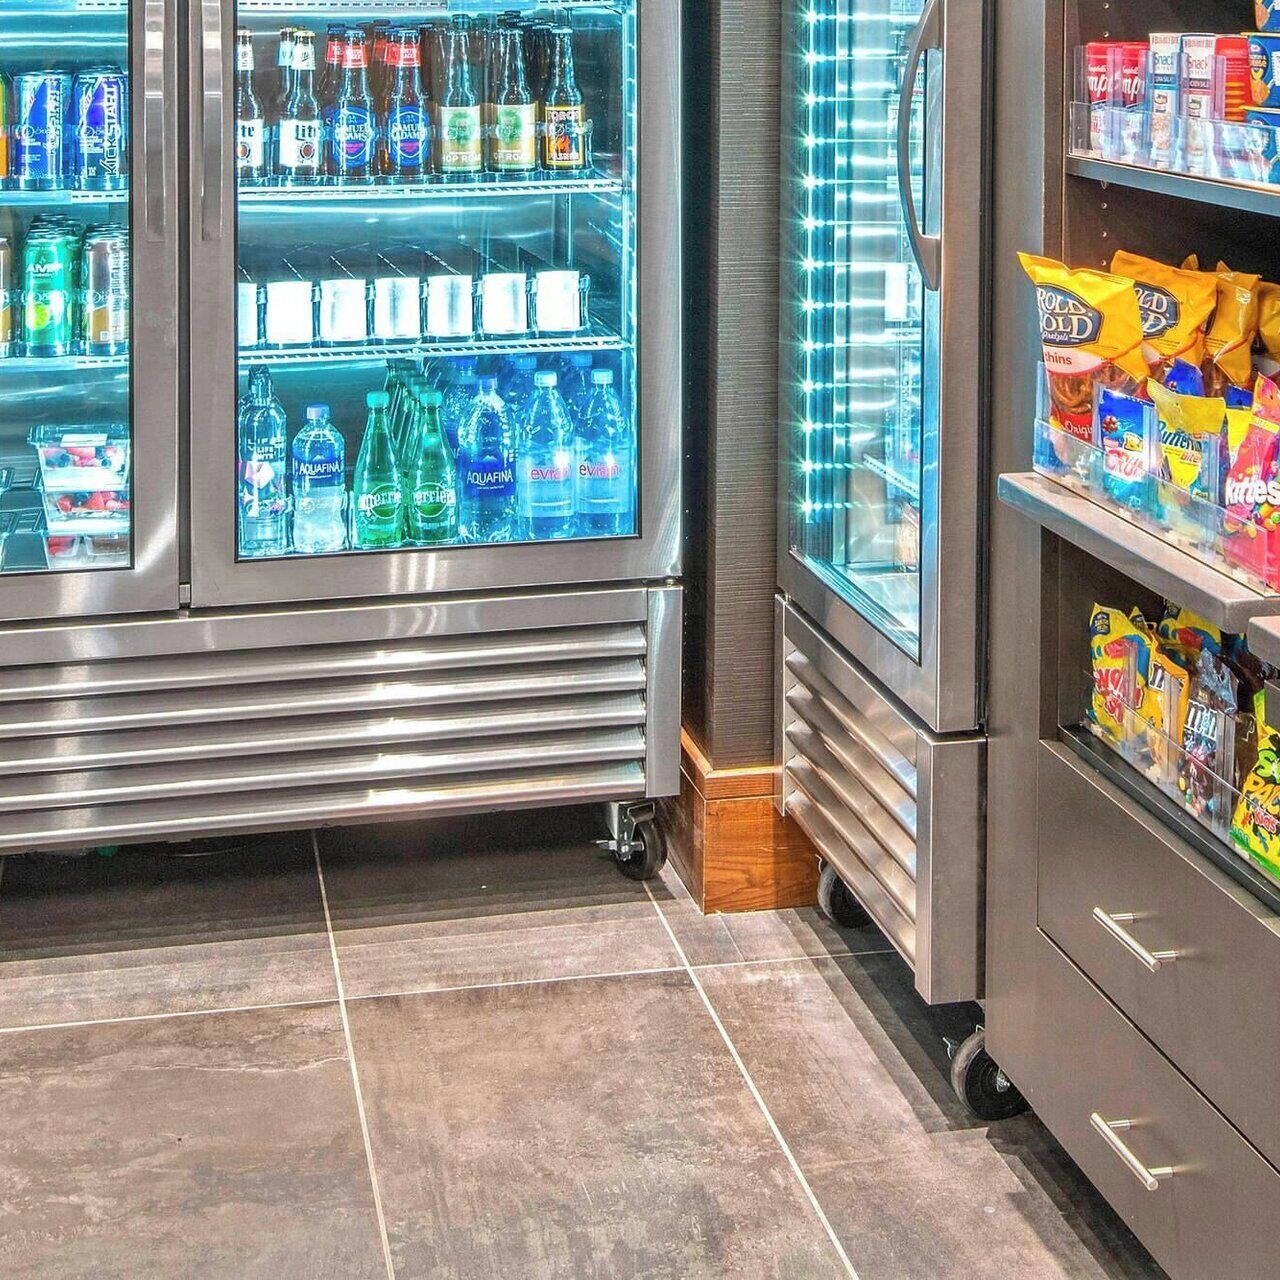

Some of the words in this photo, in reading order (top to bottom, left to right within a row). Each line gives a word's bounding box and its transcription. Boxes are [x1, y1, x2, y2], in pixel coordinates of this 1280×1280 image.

[241, 125, 255, 138] te
[298, 462, 341, 475] AQUAFINA
[579, 463, 621, 477] evian
[466, 469, 514, 486] AQUAFINA
